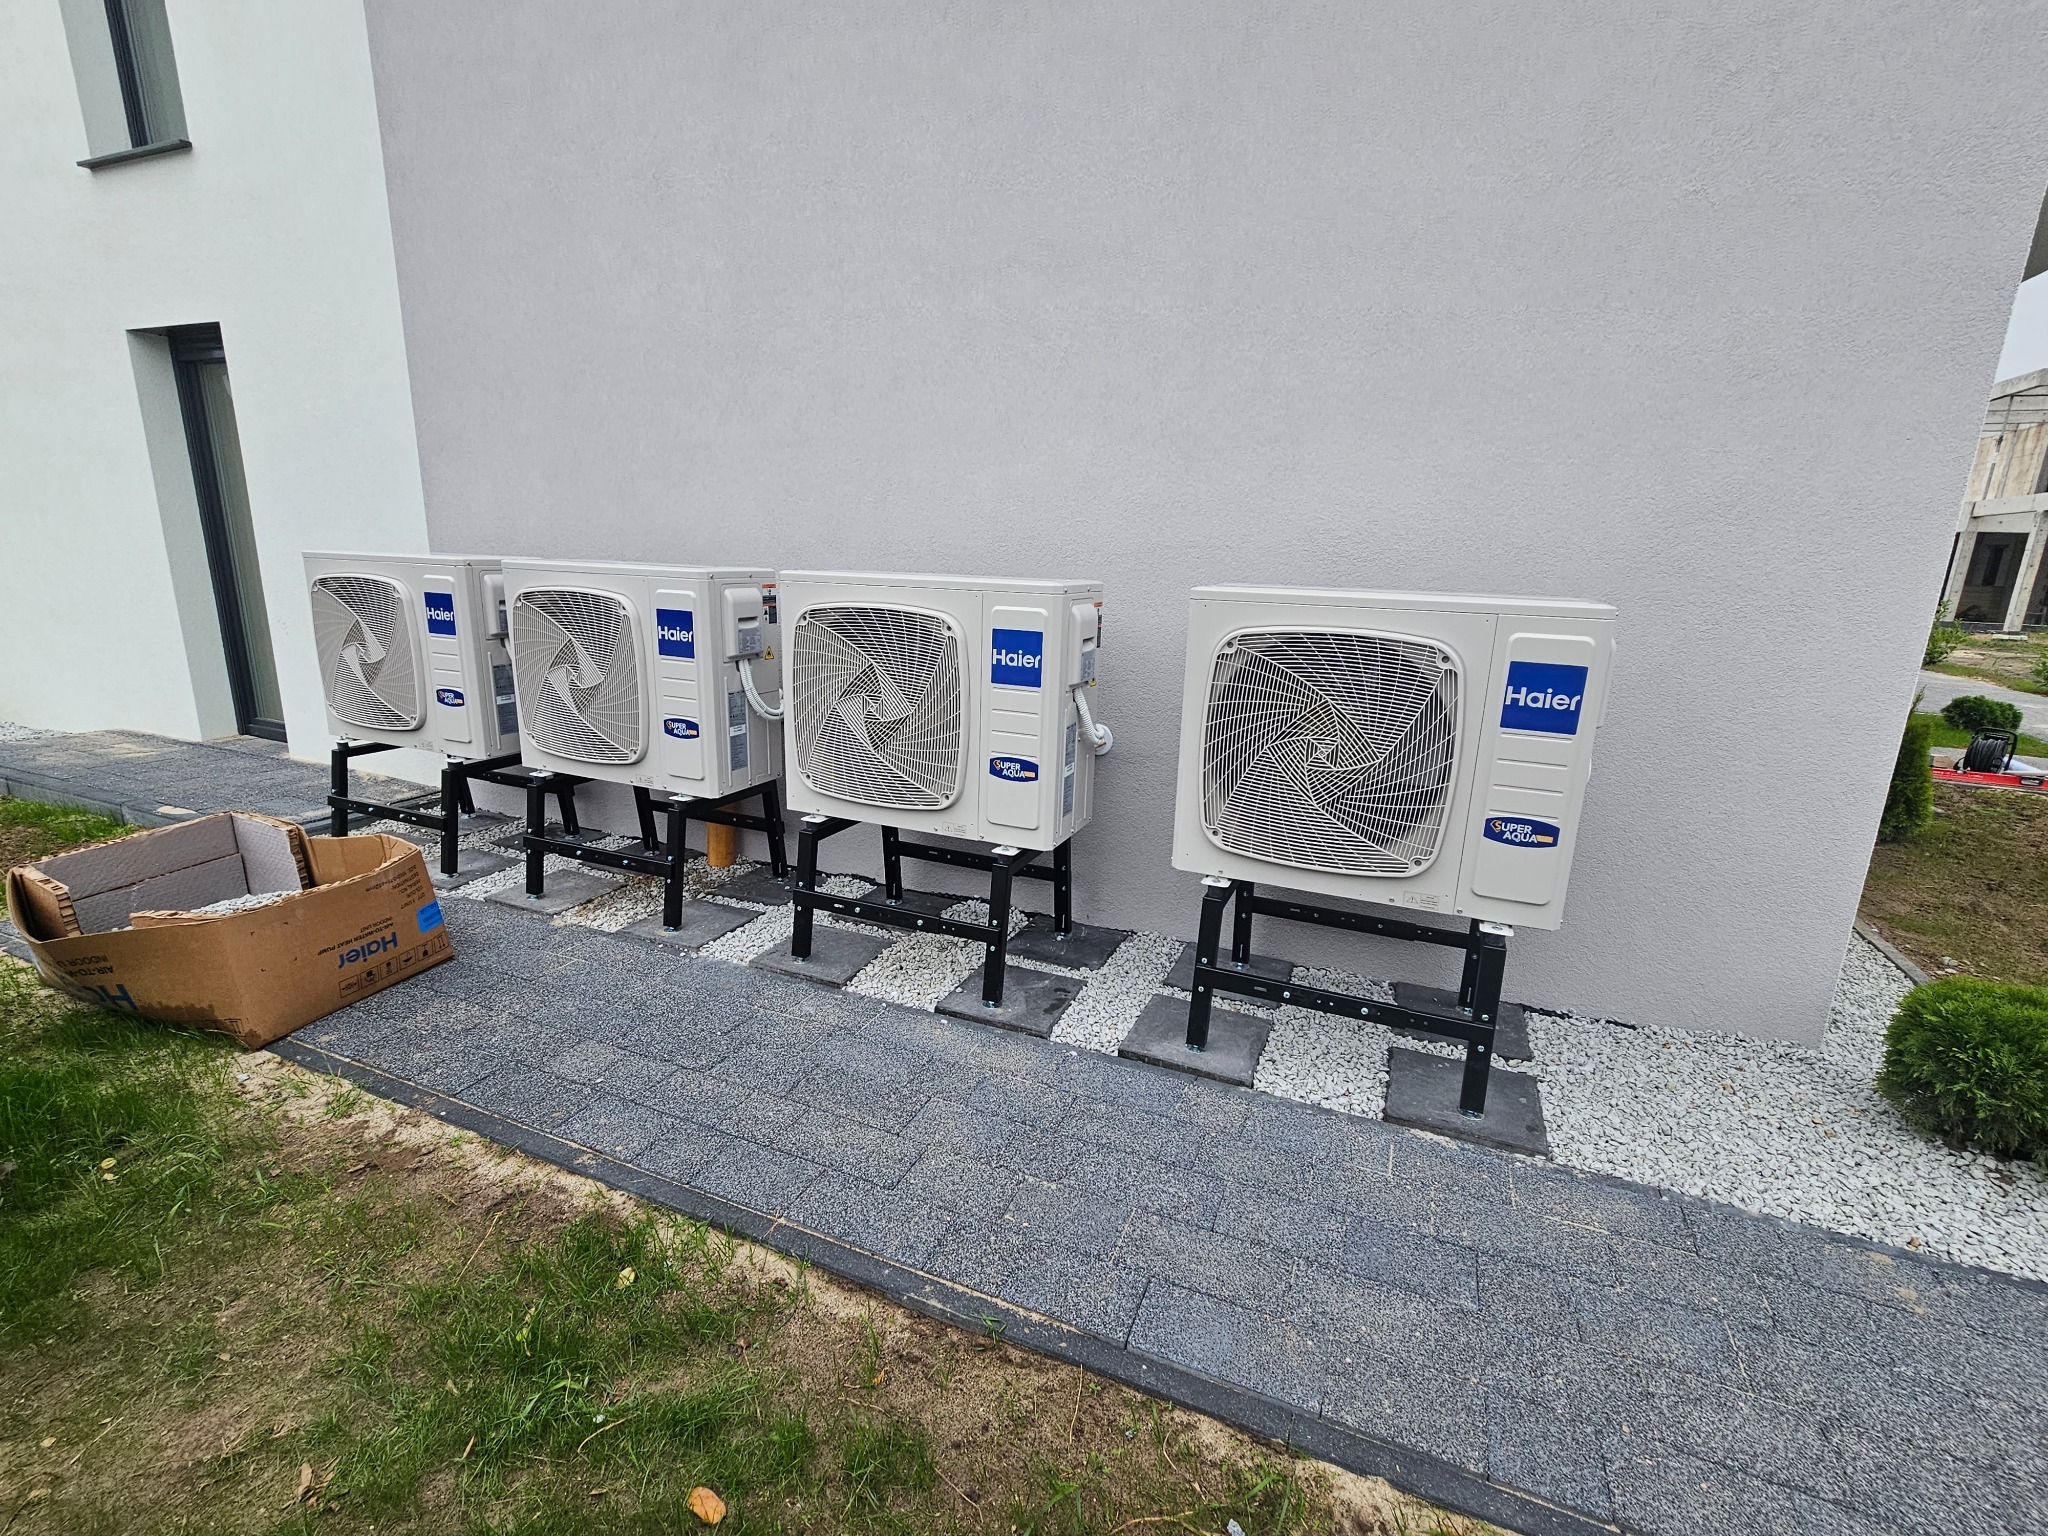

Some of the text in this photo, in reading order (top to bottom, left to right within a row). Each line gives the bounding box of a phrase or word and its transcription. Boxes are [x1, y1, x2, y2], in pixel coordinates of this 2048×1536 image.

[426, 606, 454, 622] Haier
[657, 625, 693, 643] Haier
[992, 648, 1041, 669] Haier
[1504, 685, 1581, 711] Haier
[666, 720, 687, 731] SUPER
[673, 728, 691, 736] AQUA
[993, 760, 1021, 771] SUPER
[1001, 769, 1026, 779] AQUA
[1491, 819, 1533, 834] SUPER
[1502, 831, 1538, 844] AQUA
[360, 923, 373, 934] UNIT
[337, 938, 354, 949] HEAT
[317, 944, 336, 956] PUMP
[338, 931, 399, 969] Haier
